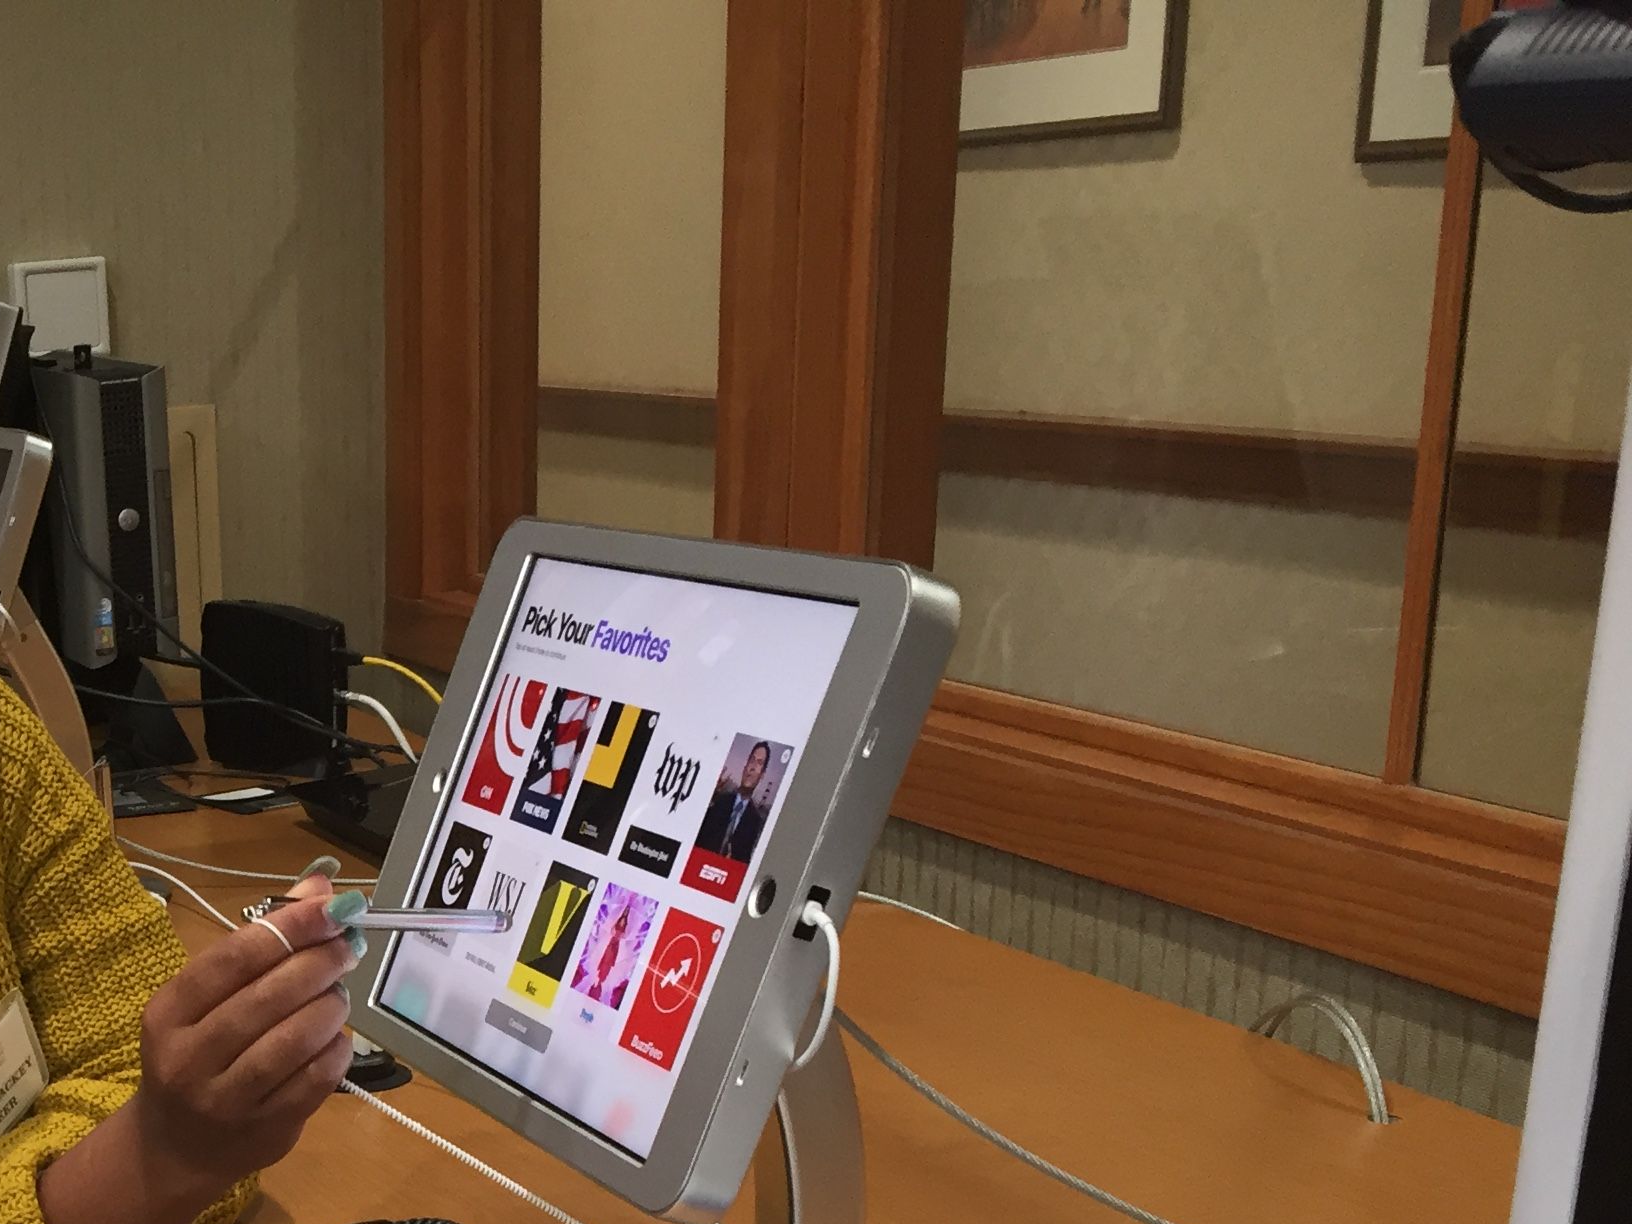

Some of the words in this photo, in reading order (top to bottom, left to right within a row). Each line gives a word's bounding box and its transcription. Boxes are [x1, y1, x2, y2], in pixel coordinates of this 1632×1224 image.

[521, 606, 558, 638] Pick
[557, 612, 595, 646] Your
[590, 619, 671, 663] Favorites
[487, 870, 527, 917] WSJ
[698, 863, 729, 886] ESPN
